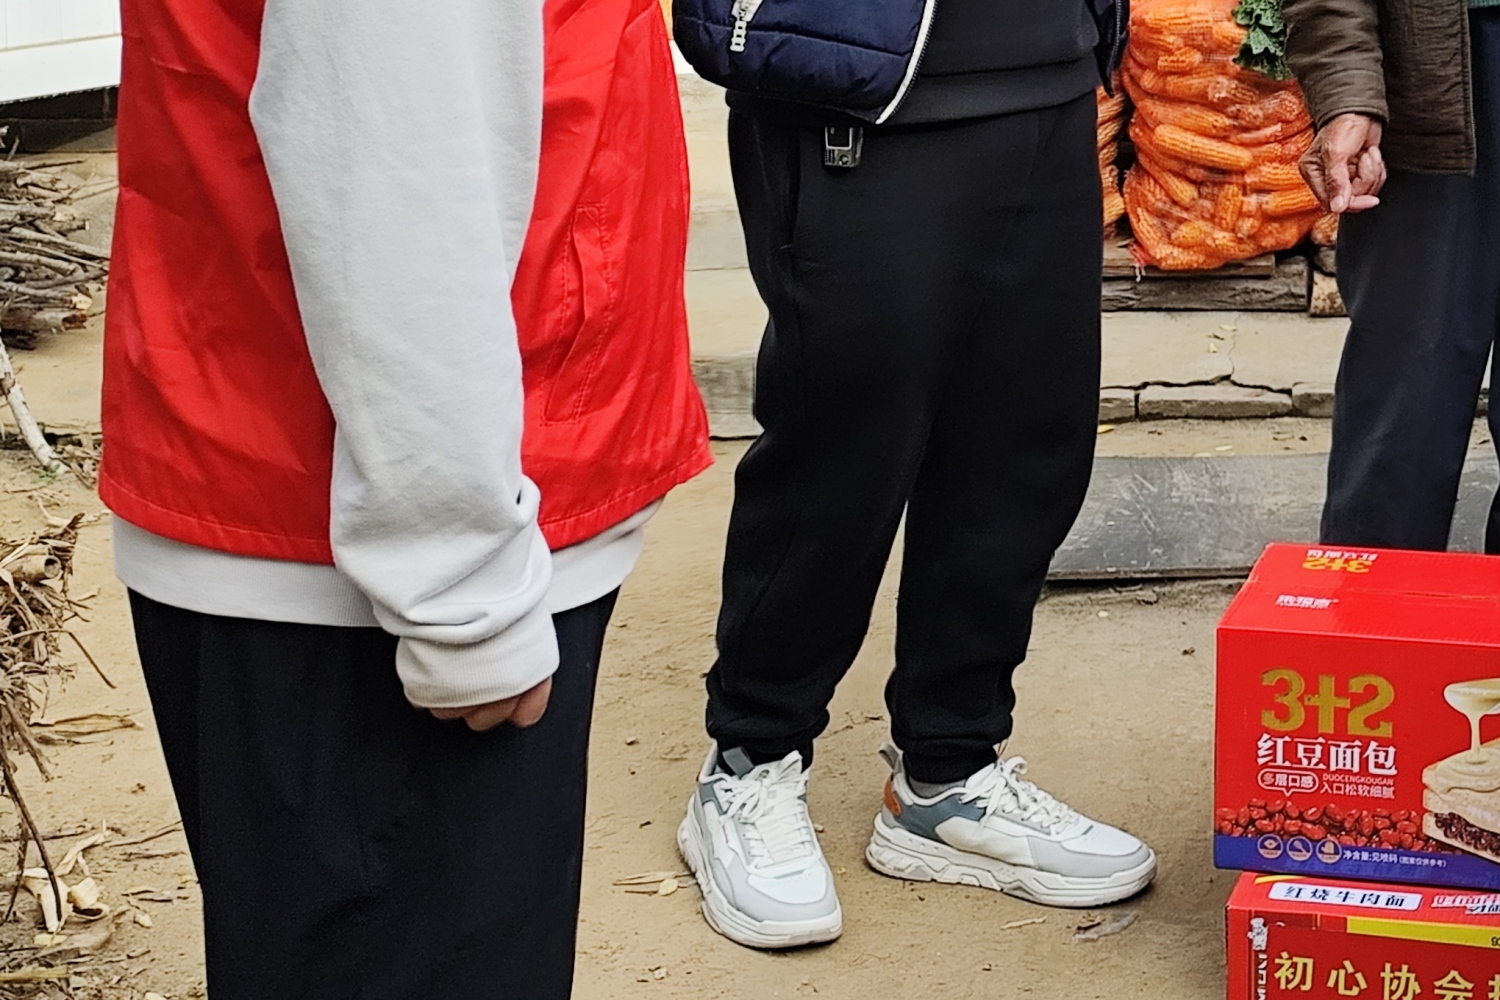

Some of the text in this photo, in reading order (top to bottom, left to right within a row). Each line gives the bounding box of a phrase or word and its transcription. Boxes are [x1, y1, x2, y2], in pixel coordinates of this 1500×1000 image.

[1261, 667, 1395, 738] 3+2
[1257, 733, 1398, 776] 红豆面包
[1262, 773, 1314, 788] 多层口感
[1320, 782, 1395, 799] 入口松软细腻
[1284, 886, 1408, 907] 红烧牛肉面
